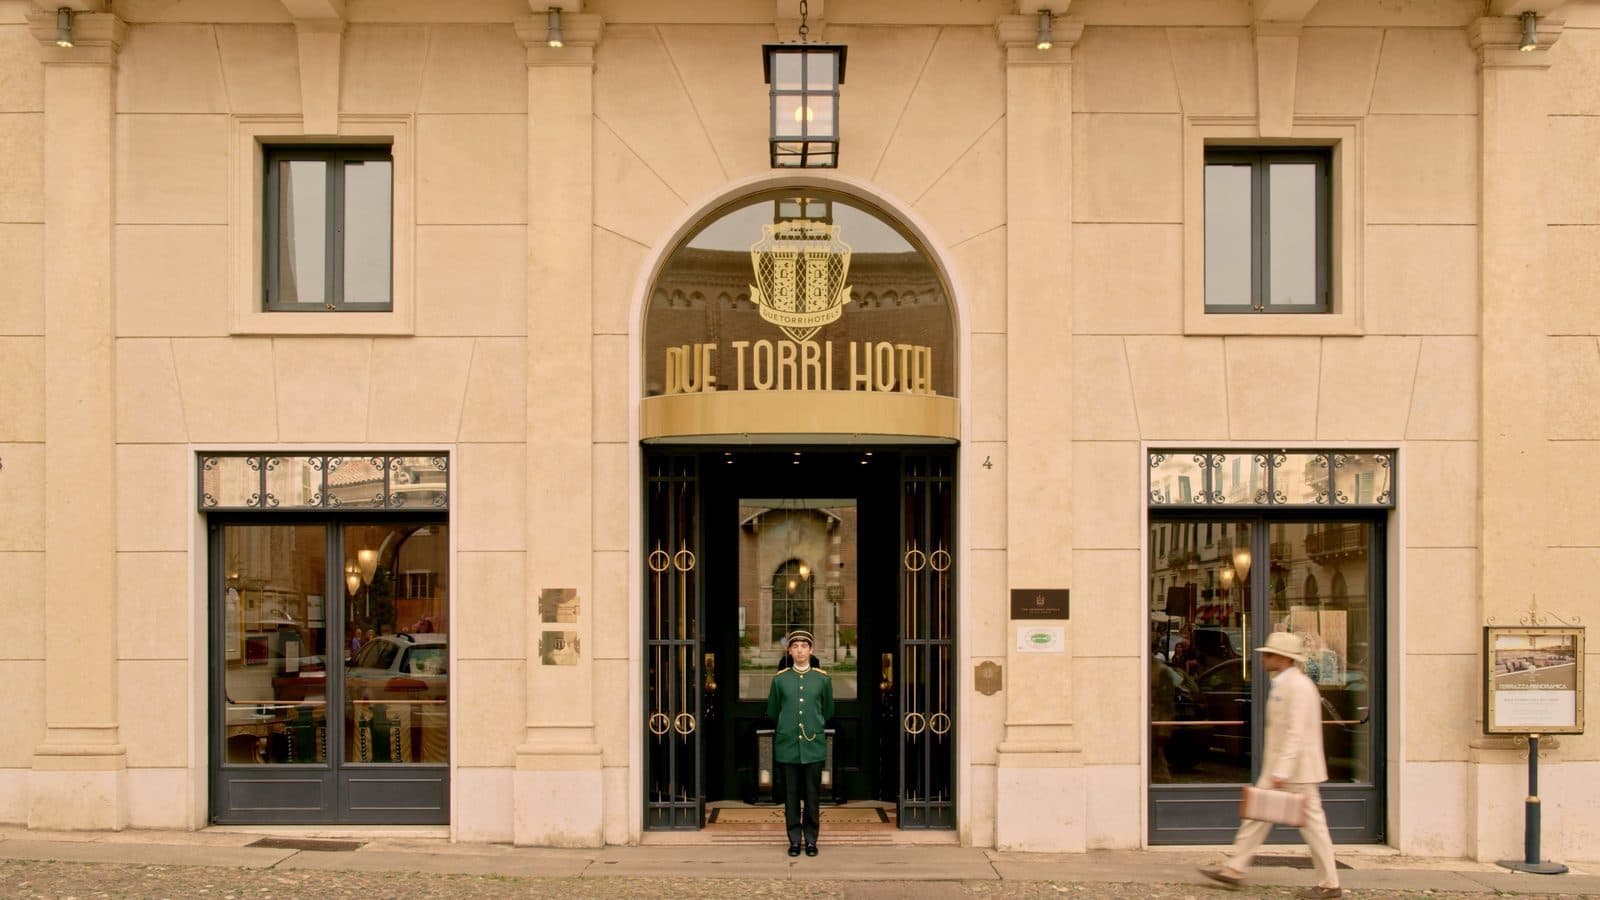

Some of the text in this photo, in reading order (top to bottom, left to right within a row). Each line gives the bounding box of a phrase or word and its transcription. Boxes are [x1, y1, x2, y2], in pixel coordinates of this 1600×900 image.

[666, 339, 936, 395] DUE TORRI HOTEL
[982, 455, 993, 470] 4
